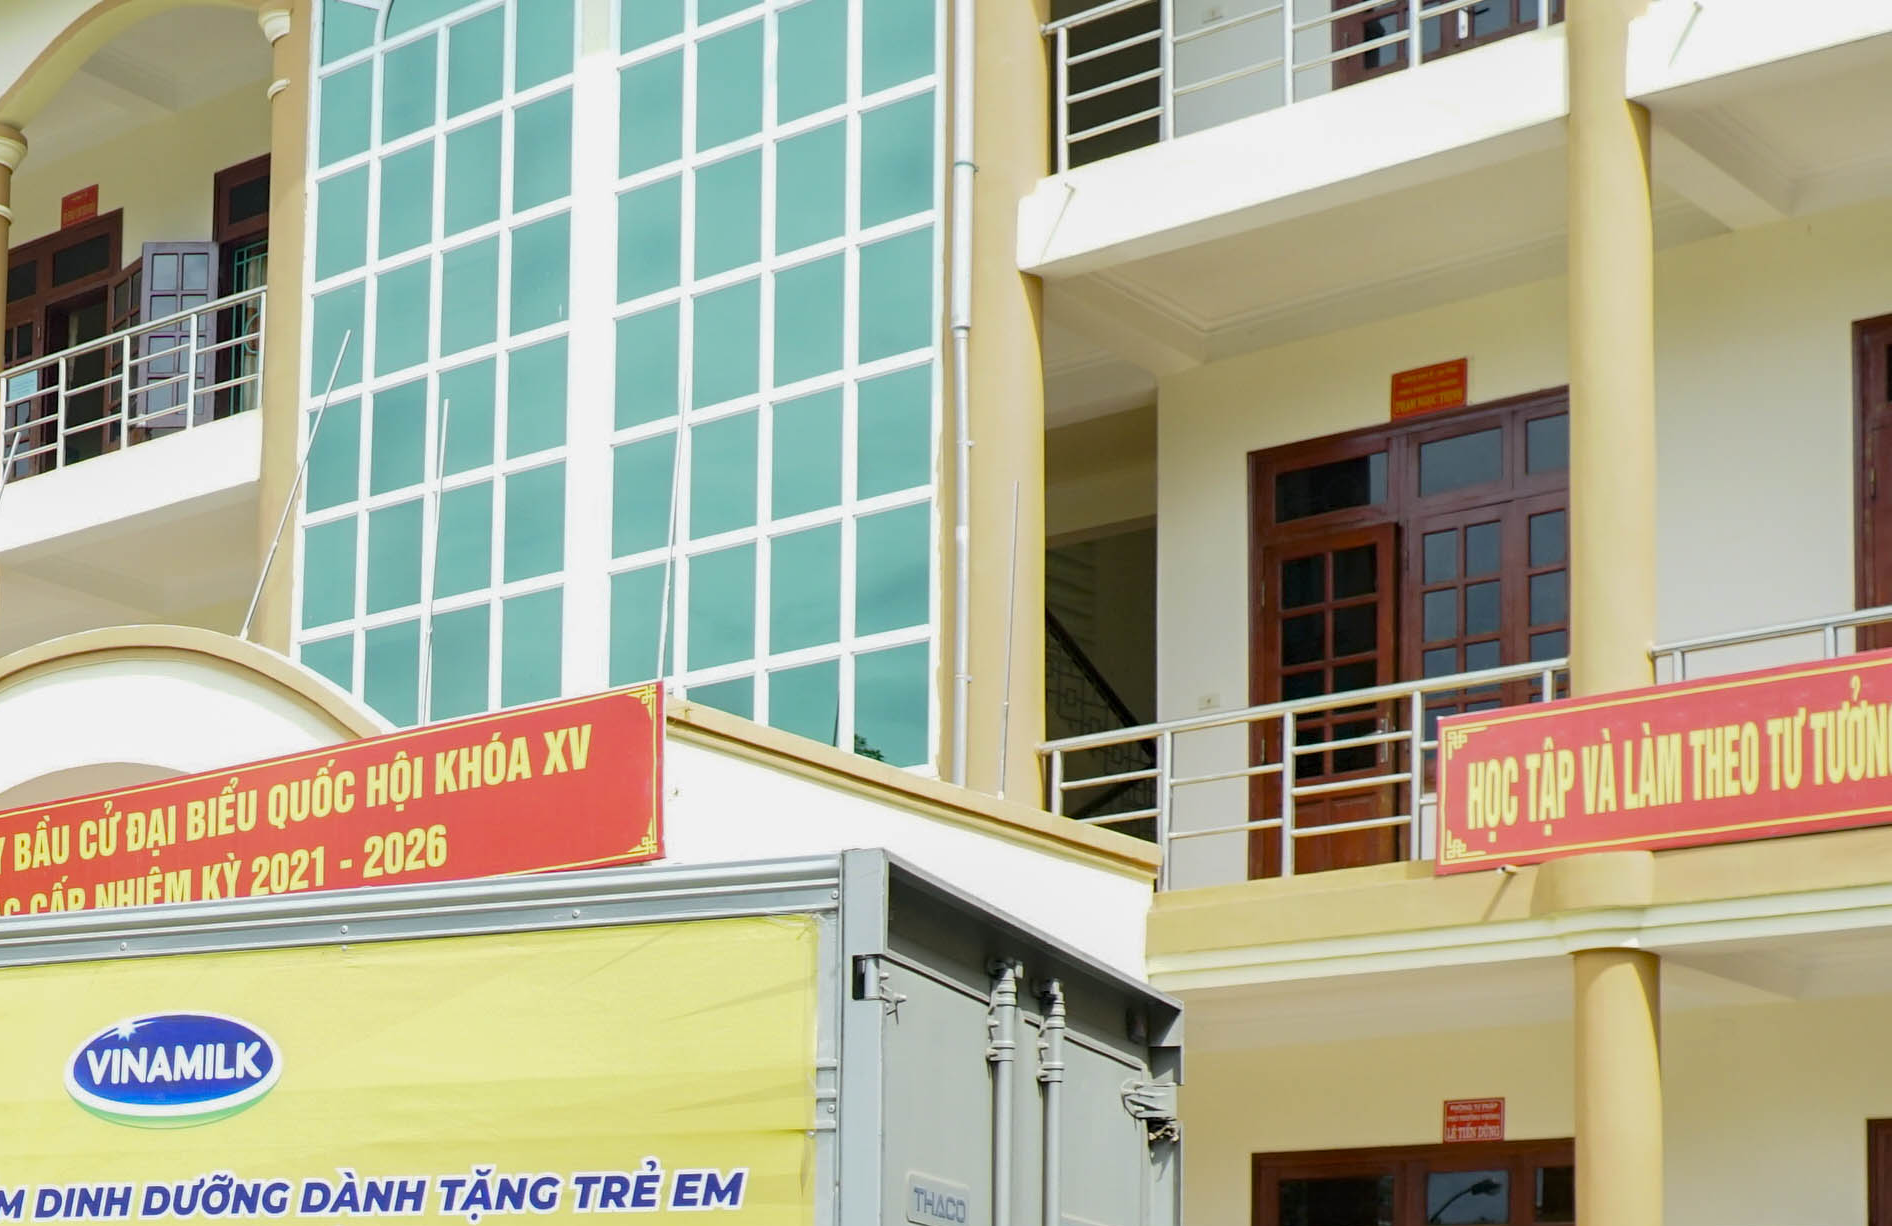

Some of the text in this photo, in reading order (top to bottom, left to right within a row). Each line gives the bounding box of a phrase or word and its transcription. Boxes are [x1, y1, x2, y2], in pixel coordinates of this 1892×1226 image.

[1466, 674, 1892, 843] HỌC TẬP VÀ LÀM THEO TƯ TƯỞN
[13, 815, 71, 872] BẦU
[79, 801, 122, 861] CỬ
[125, 810, 177, 858] ĐẠI
[186, 776, 258, 841] BIỂU
[267, 759, 355, 829] QUỐC
[366, 751, 424, 813] HỘI
[435, 739, 532, 795] KHÓA
[542, 725, 593, 777] XV
[203, 853, 243, 900] KỲ
[250, 846, 326, 897] 2021
[363, 825, 449, 877] 2026
[86, 1042, 263, 1086] VINAMILK
[36, 1186, 132, 1219] DINH
[142, 1172, 288, 1217] DƯỠNG
[300, 1171, 425, 1213] DÀNH
[441, 1168, 561, 1220] TẶNG
[573, 1159, 662, 1210] TRẺ
[671, 1171, 744, 1207] EM
[914, 1187, 967, 1224] THACO
